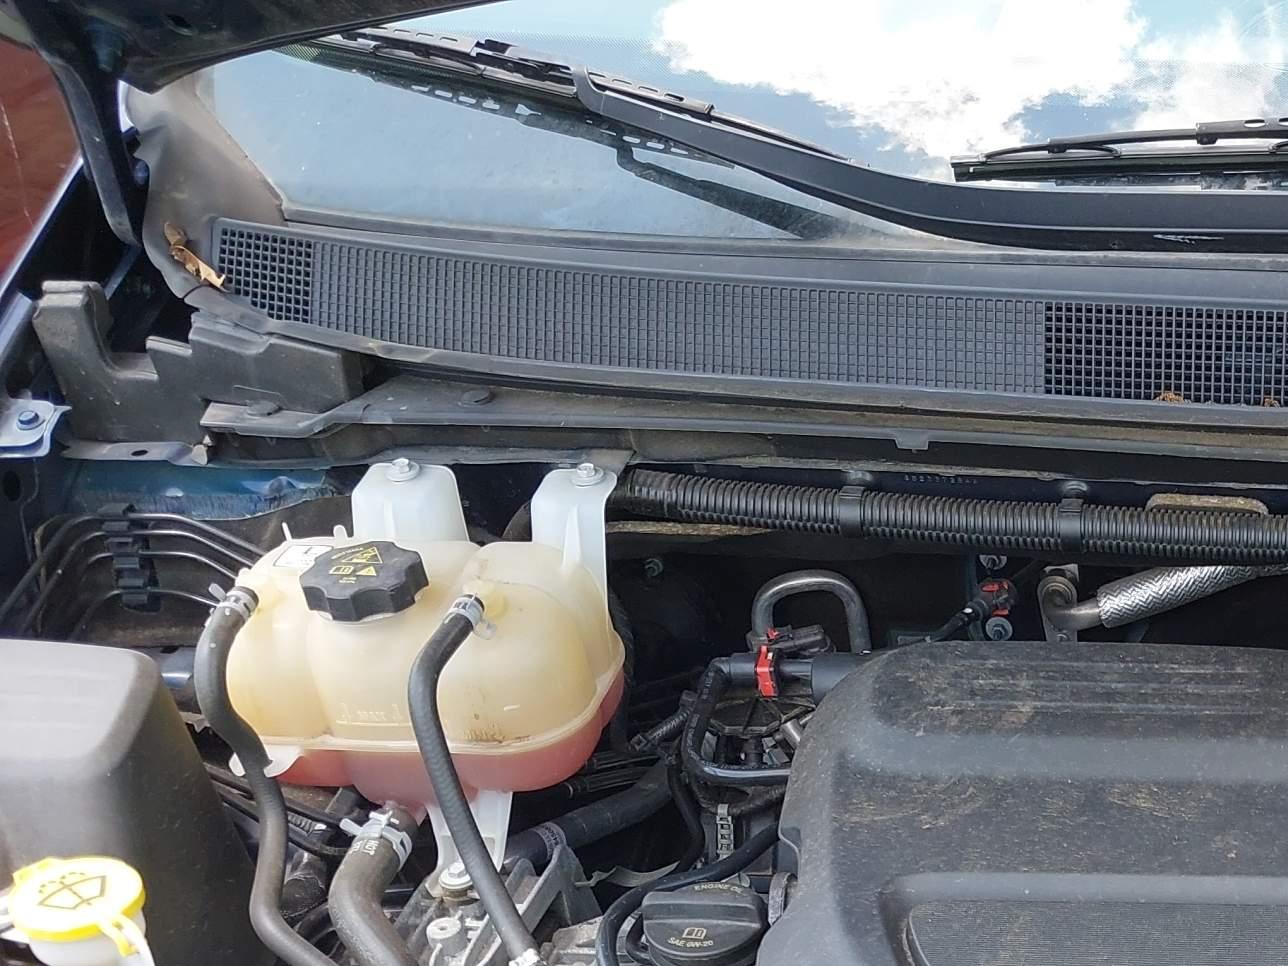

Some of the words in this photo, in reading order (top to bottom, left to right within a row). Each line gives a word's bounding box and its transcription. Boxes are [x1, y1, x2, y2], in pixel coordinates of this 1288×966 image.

[694, 883, 730, 891] ENGINE
[668, 937, 686, 947] SAE
[686, 939, 714, 948] 0W-20
